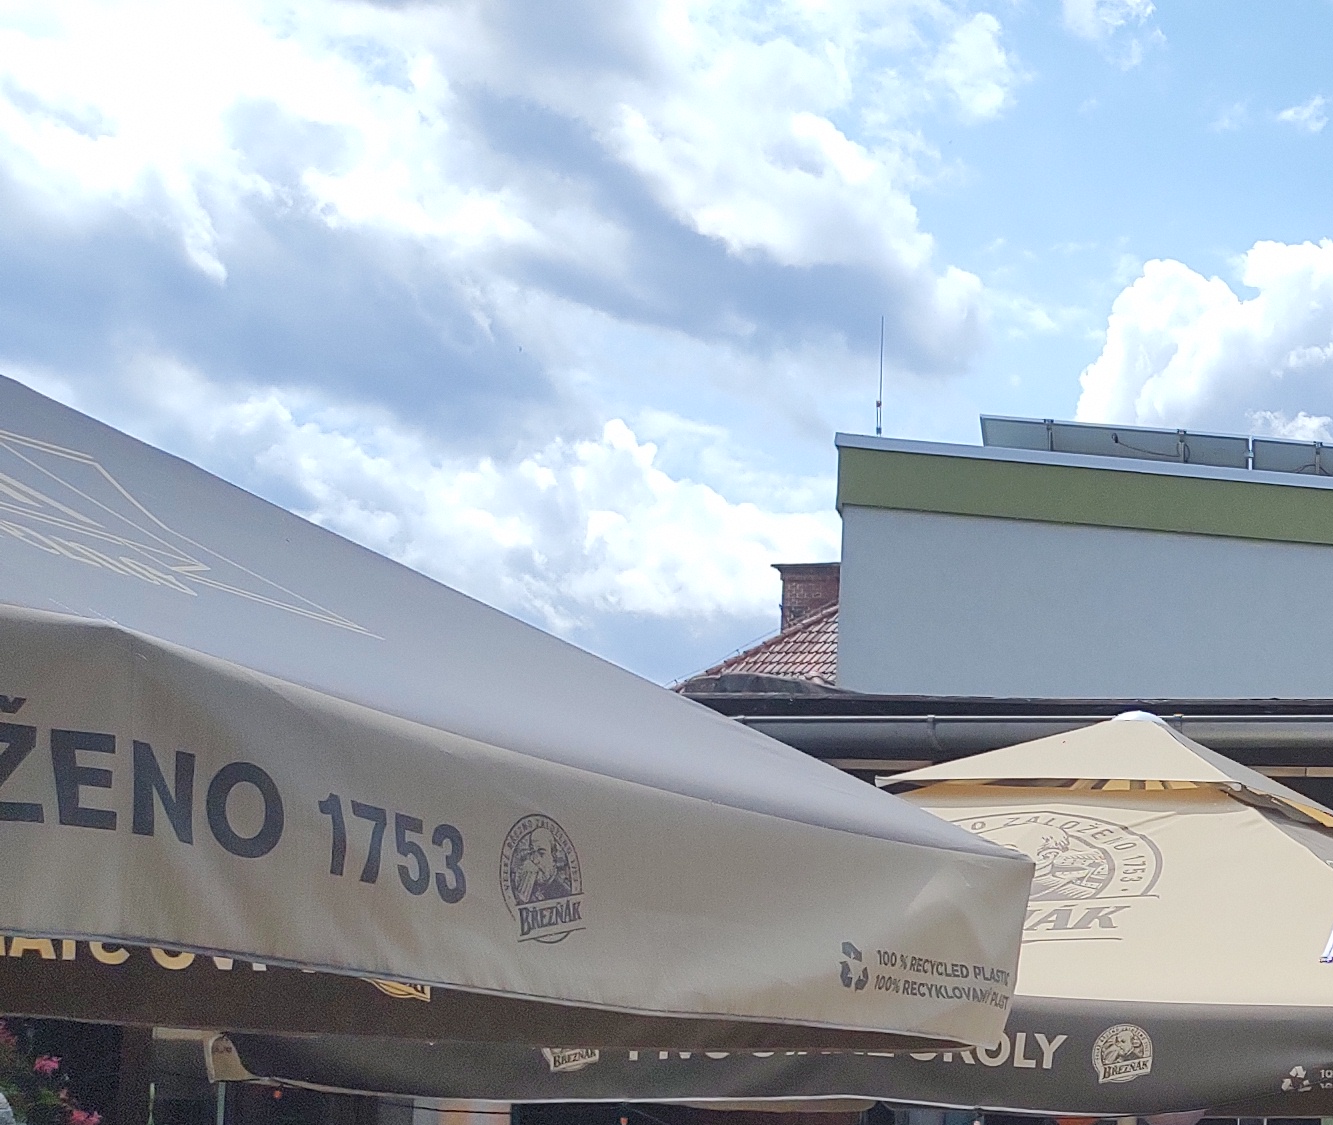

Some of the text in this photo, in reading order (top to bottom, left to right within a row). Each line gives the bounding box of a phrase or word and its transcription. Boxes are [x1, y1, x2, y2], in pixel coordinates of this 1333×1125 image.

[318, 793, 467, 904] 1753
[877, 949, 897, 967] 100
[910, 956, 969, 979] RECYCLED
